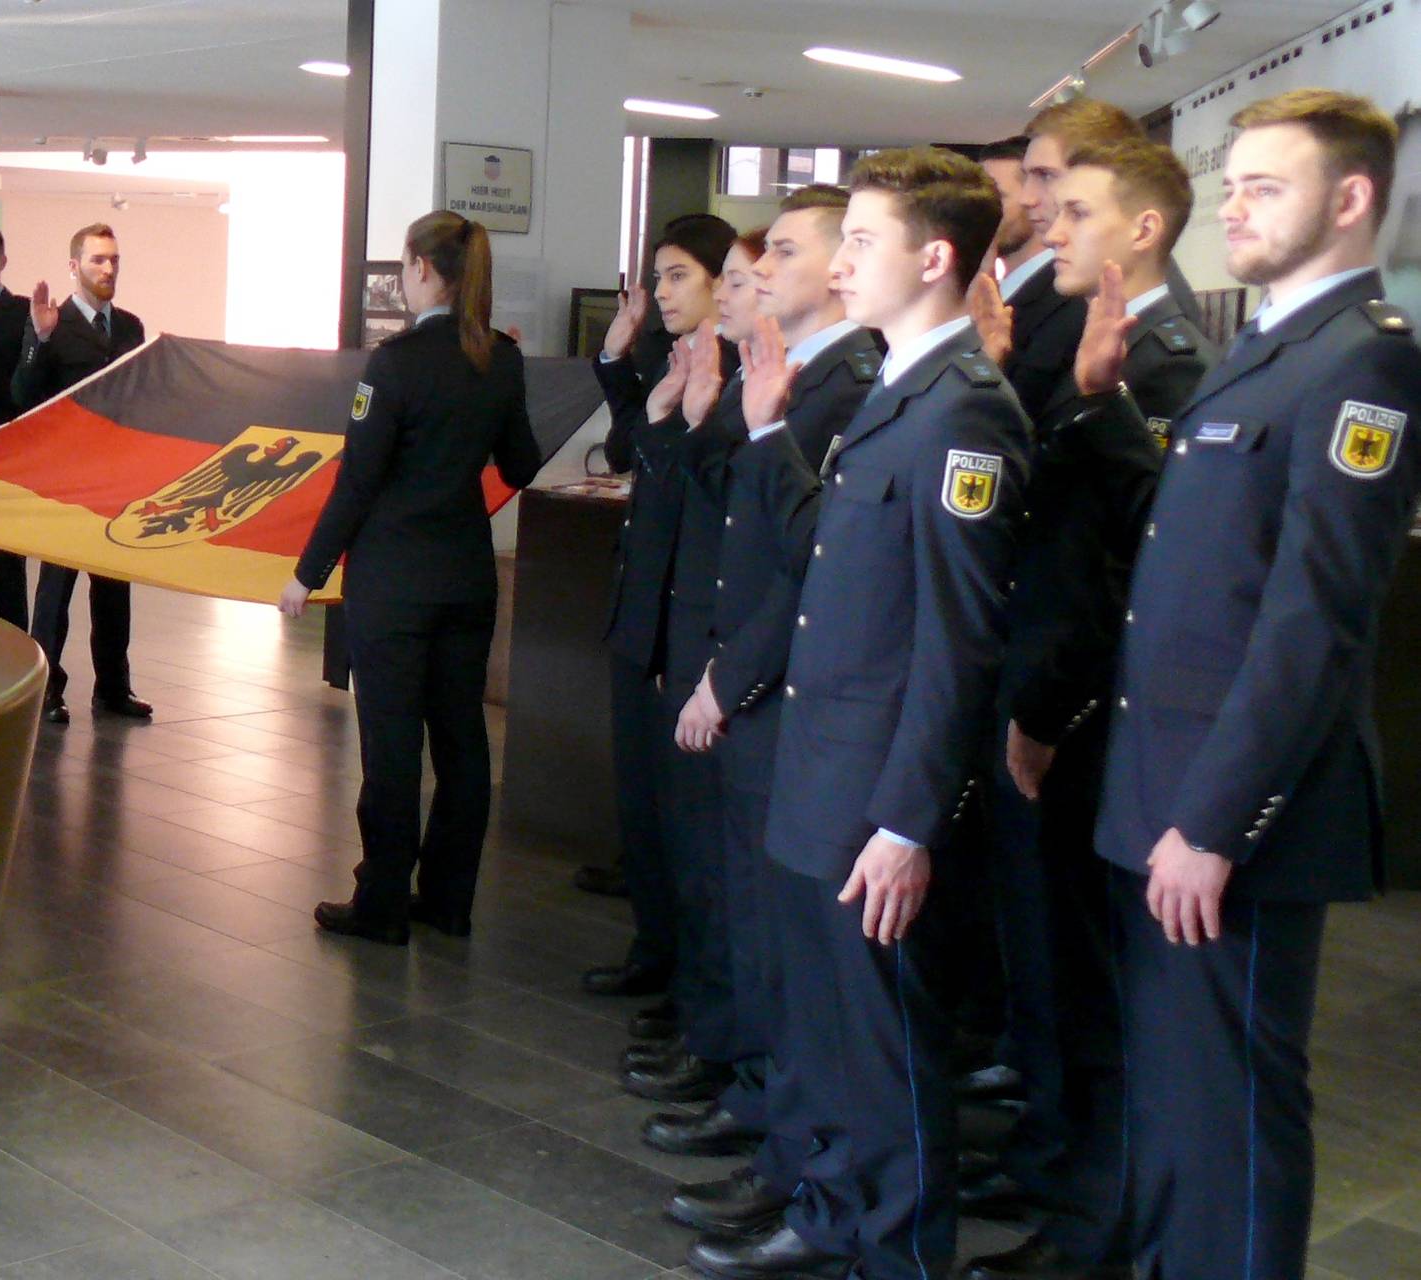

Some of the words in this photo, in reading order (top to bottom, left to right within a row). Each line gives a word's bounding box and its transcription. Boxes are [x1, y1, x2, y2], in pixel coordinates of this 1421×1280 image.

[449, 200, 467, 210] DER
[1347, 406, 1402, 430] POLIZEI
[951, 455, 997, 472] POLIZEI
